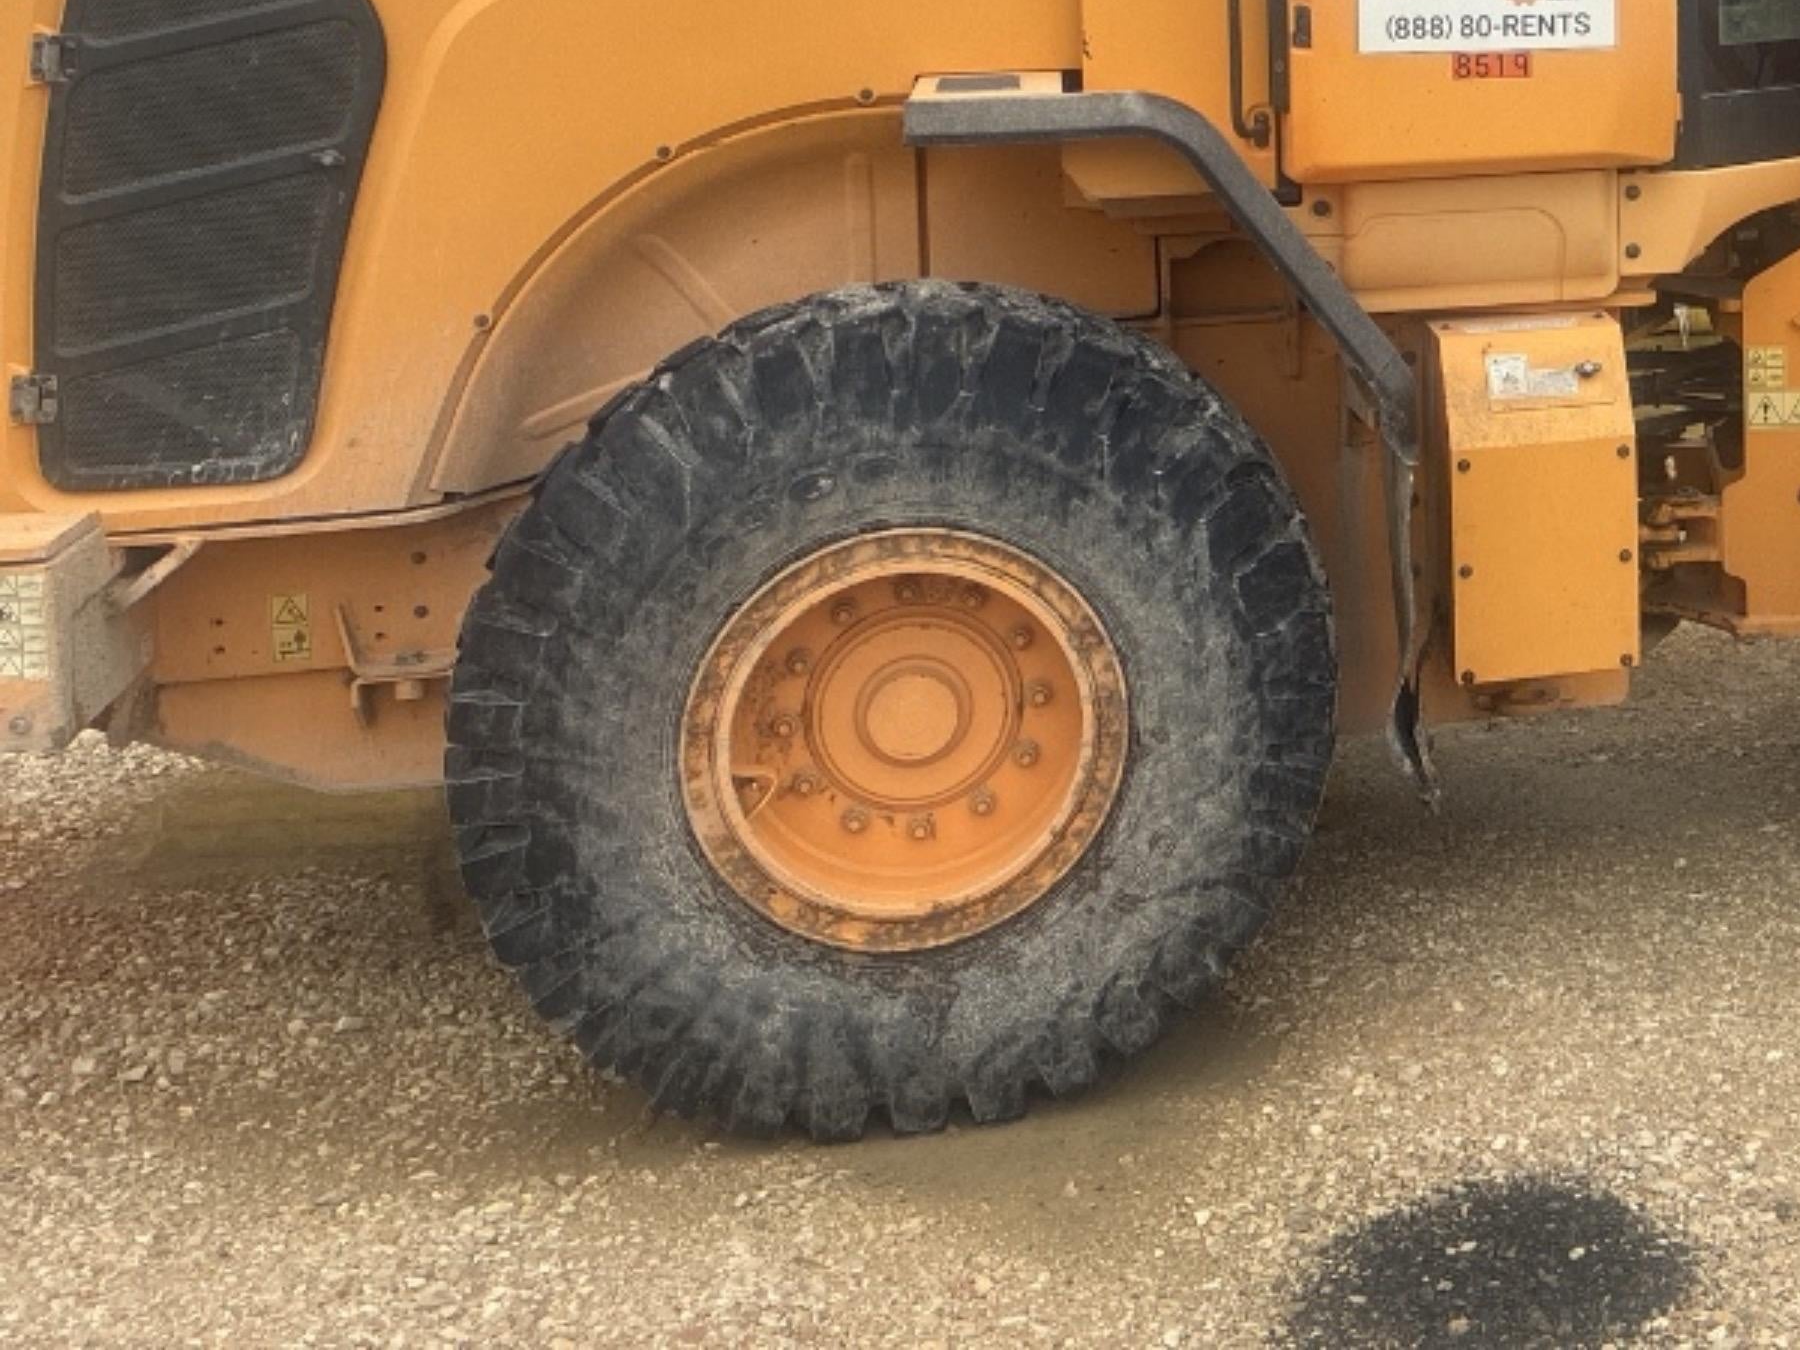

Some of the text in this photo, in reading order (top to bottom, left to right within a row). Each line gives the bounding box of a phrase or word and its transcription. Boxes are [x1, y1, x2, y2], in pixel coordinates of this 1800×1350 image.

[1386, 12, 1592, 42] (888) 80-RENTS
[1454, 53, 1530, 79] 8519
